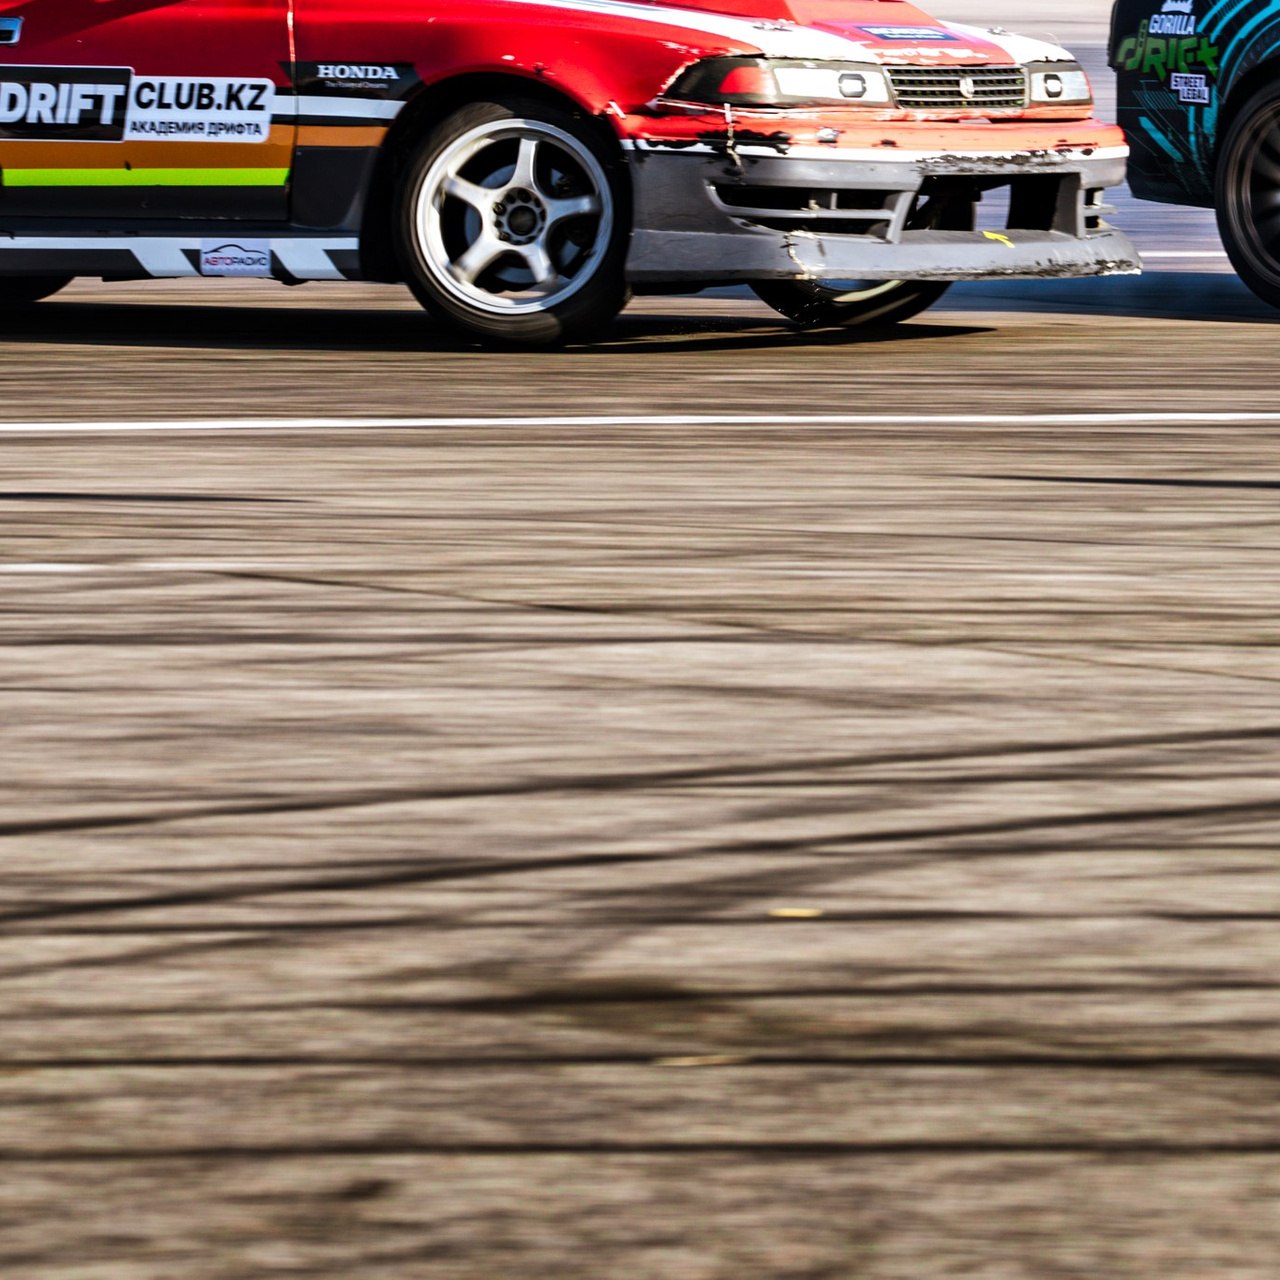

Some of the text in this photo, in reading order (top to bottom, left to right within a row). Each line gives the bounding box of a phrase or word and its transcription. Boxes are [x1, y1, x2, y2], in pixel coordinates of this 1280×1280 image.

[1148, 14, 1197, 35] GORILLA
[317, 64, 400, 80] HONDA
[1172, 74, 1205, 88] STREET
[0, 82, 126, 125] DRIFT
[135, 82, 268, 111] CLUB.KZ
[129, 121, 263, 136] АКАДЕМИЯ ДРИФТА
